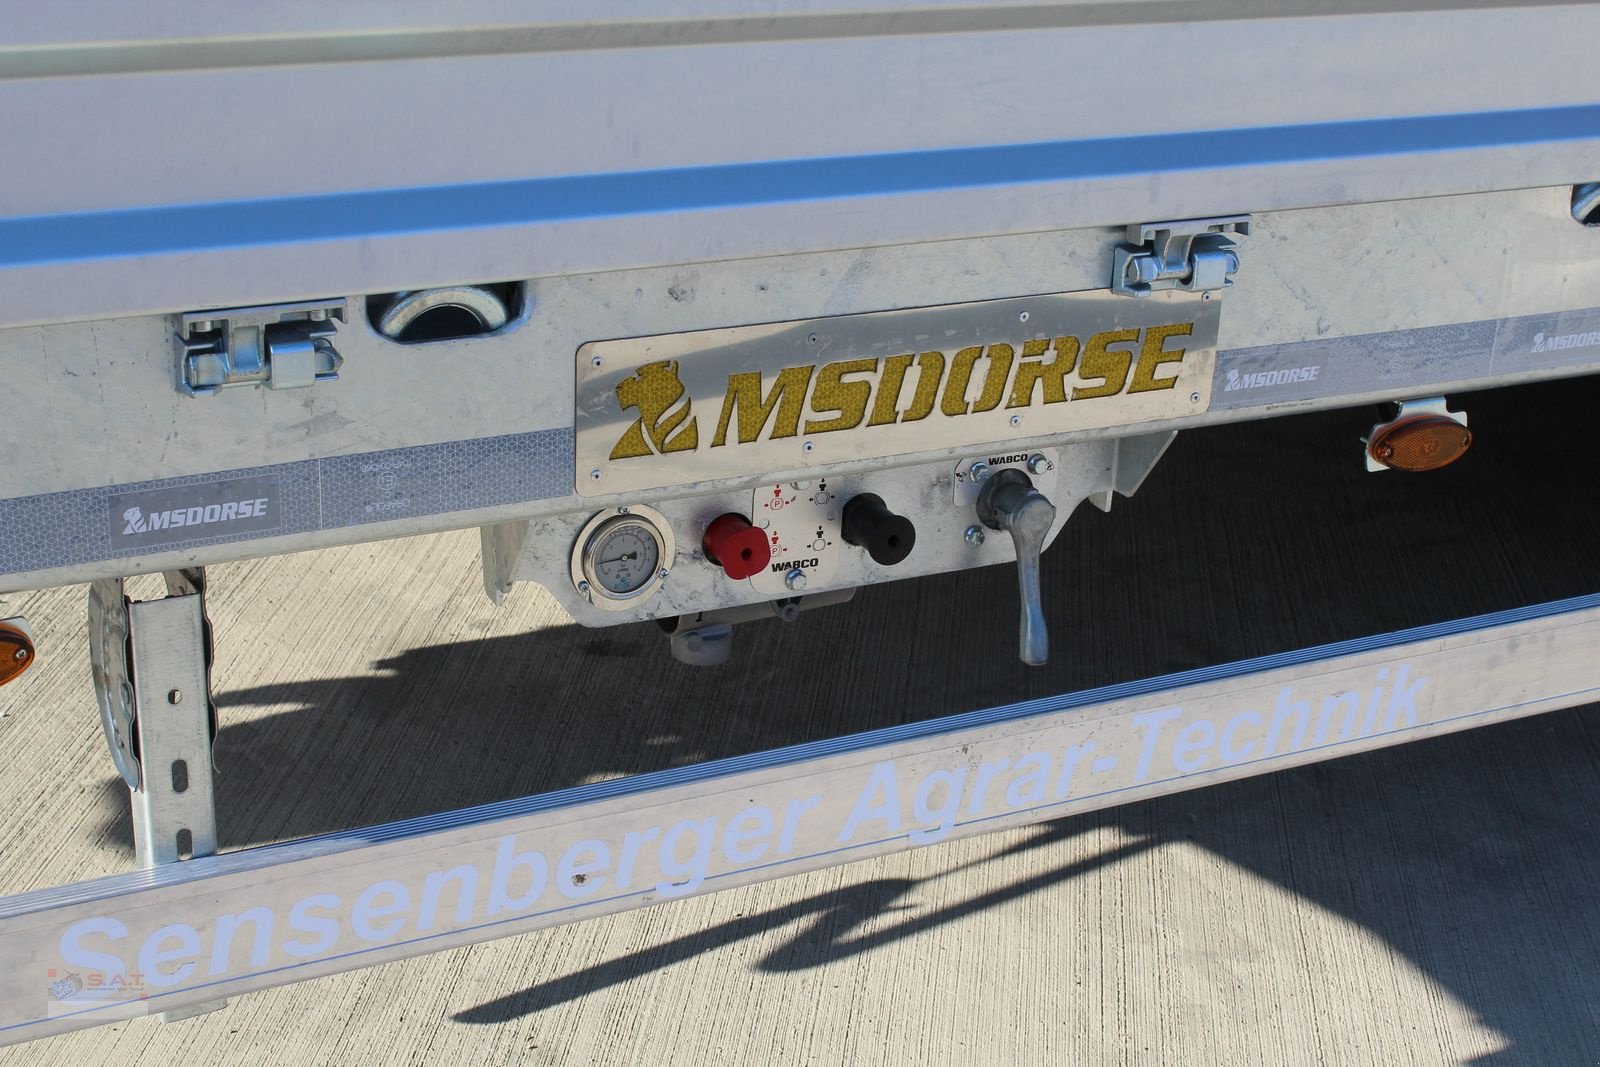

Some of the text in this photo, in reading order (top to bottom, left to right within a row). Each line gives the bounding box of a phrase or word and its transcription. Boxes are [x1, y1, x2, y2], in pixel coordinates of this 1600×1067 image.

[710, 322, 1194, 448] MSDORSE
[1240, 366, 1320, 390] MSDORSE
[988, 453, 1028, 466] WABCO
[147, 498, 269, 531] MSDORSE
[771, 558, 819, 572] WABCO
[58, 663, 1431, 1005] Sensenberger Agrar-Technik
